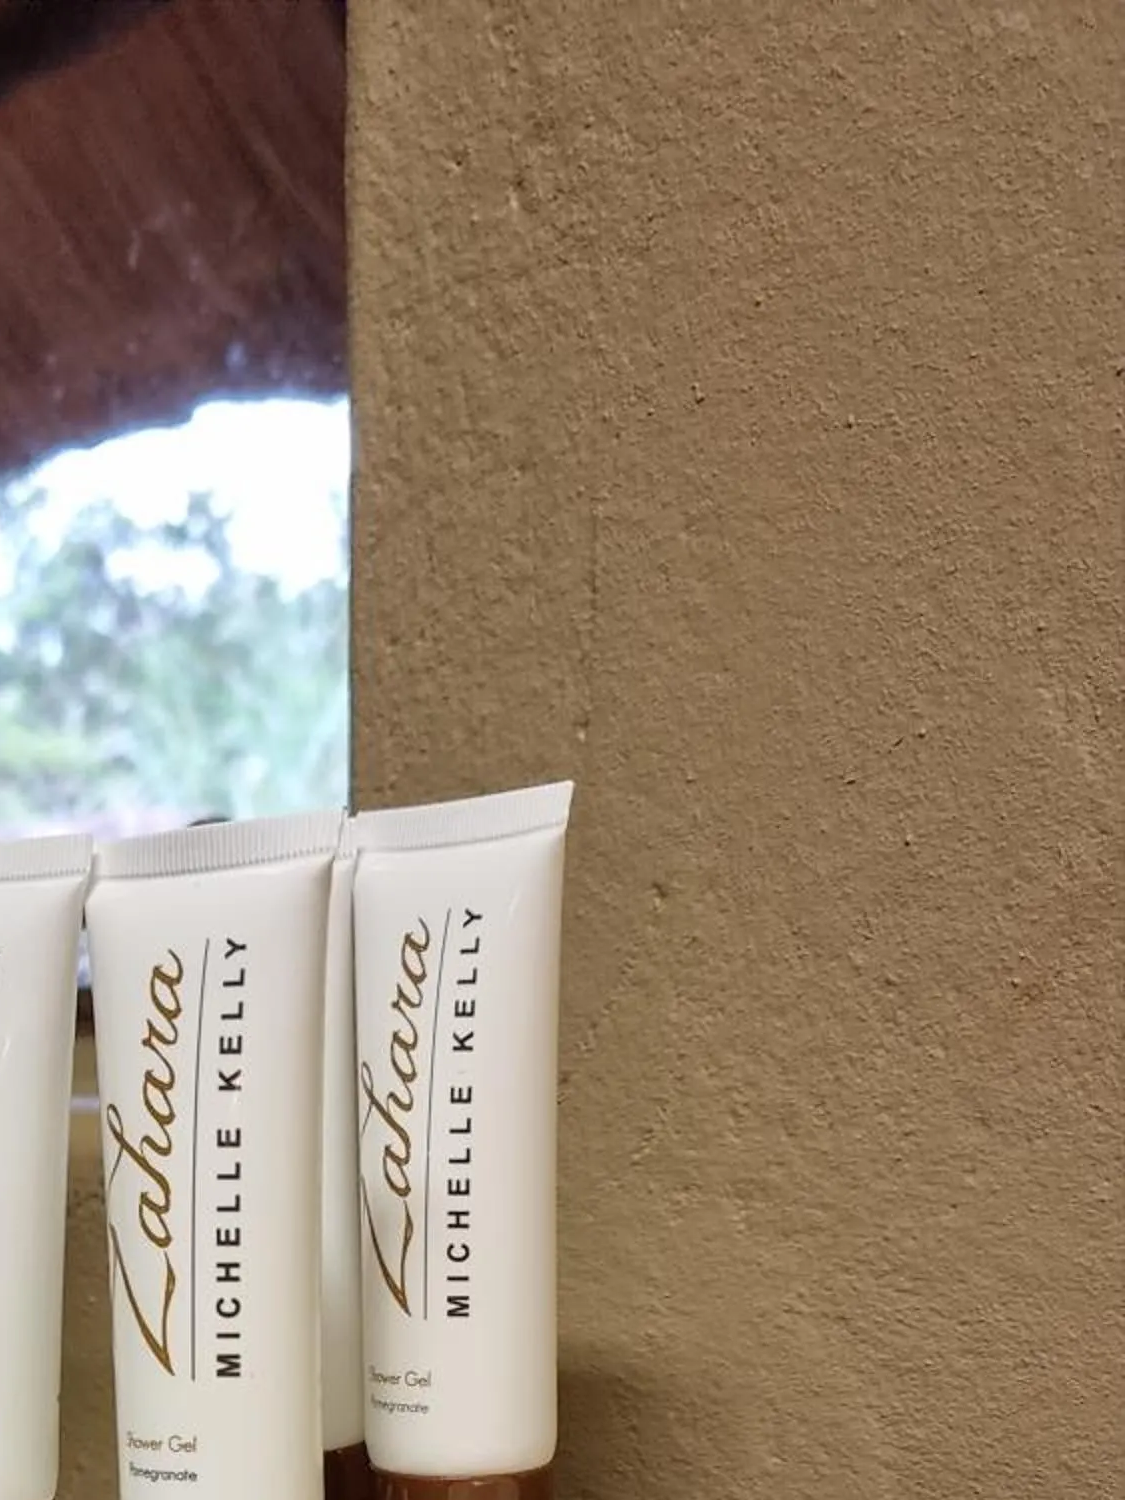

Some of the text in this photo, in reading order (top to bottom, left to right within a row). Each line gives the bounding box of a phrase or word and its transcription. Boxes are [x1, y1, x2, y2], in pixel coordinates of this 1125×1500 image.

[108, 947, 184, 1377] Zahara
[215, 937, 248, 1378] MICHELLE KELLY
[360, 915, 431, 1318] Zahara
[446, 907, 484, 1318] MICHELLE KELLY
[168, 1434, 198, 1453] Gel
[405, 1370, 432, 1387] Gel
